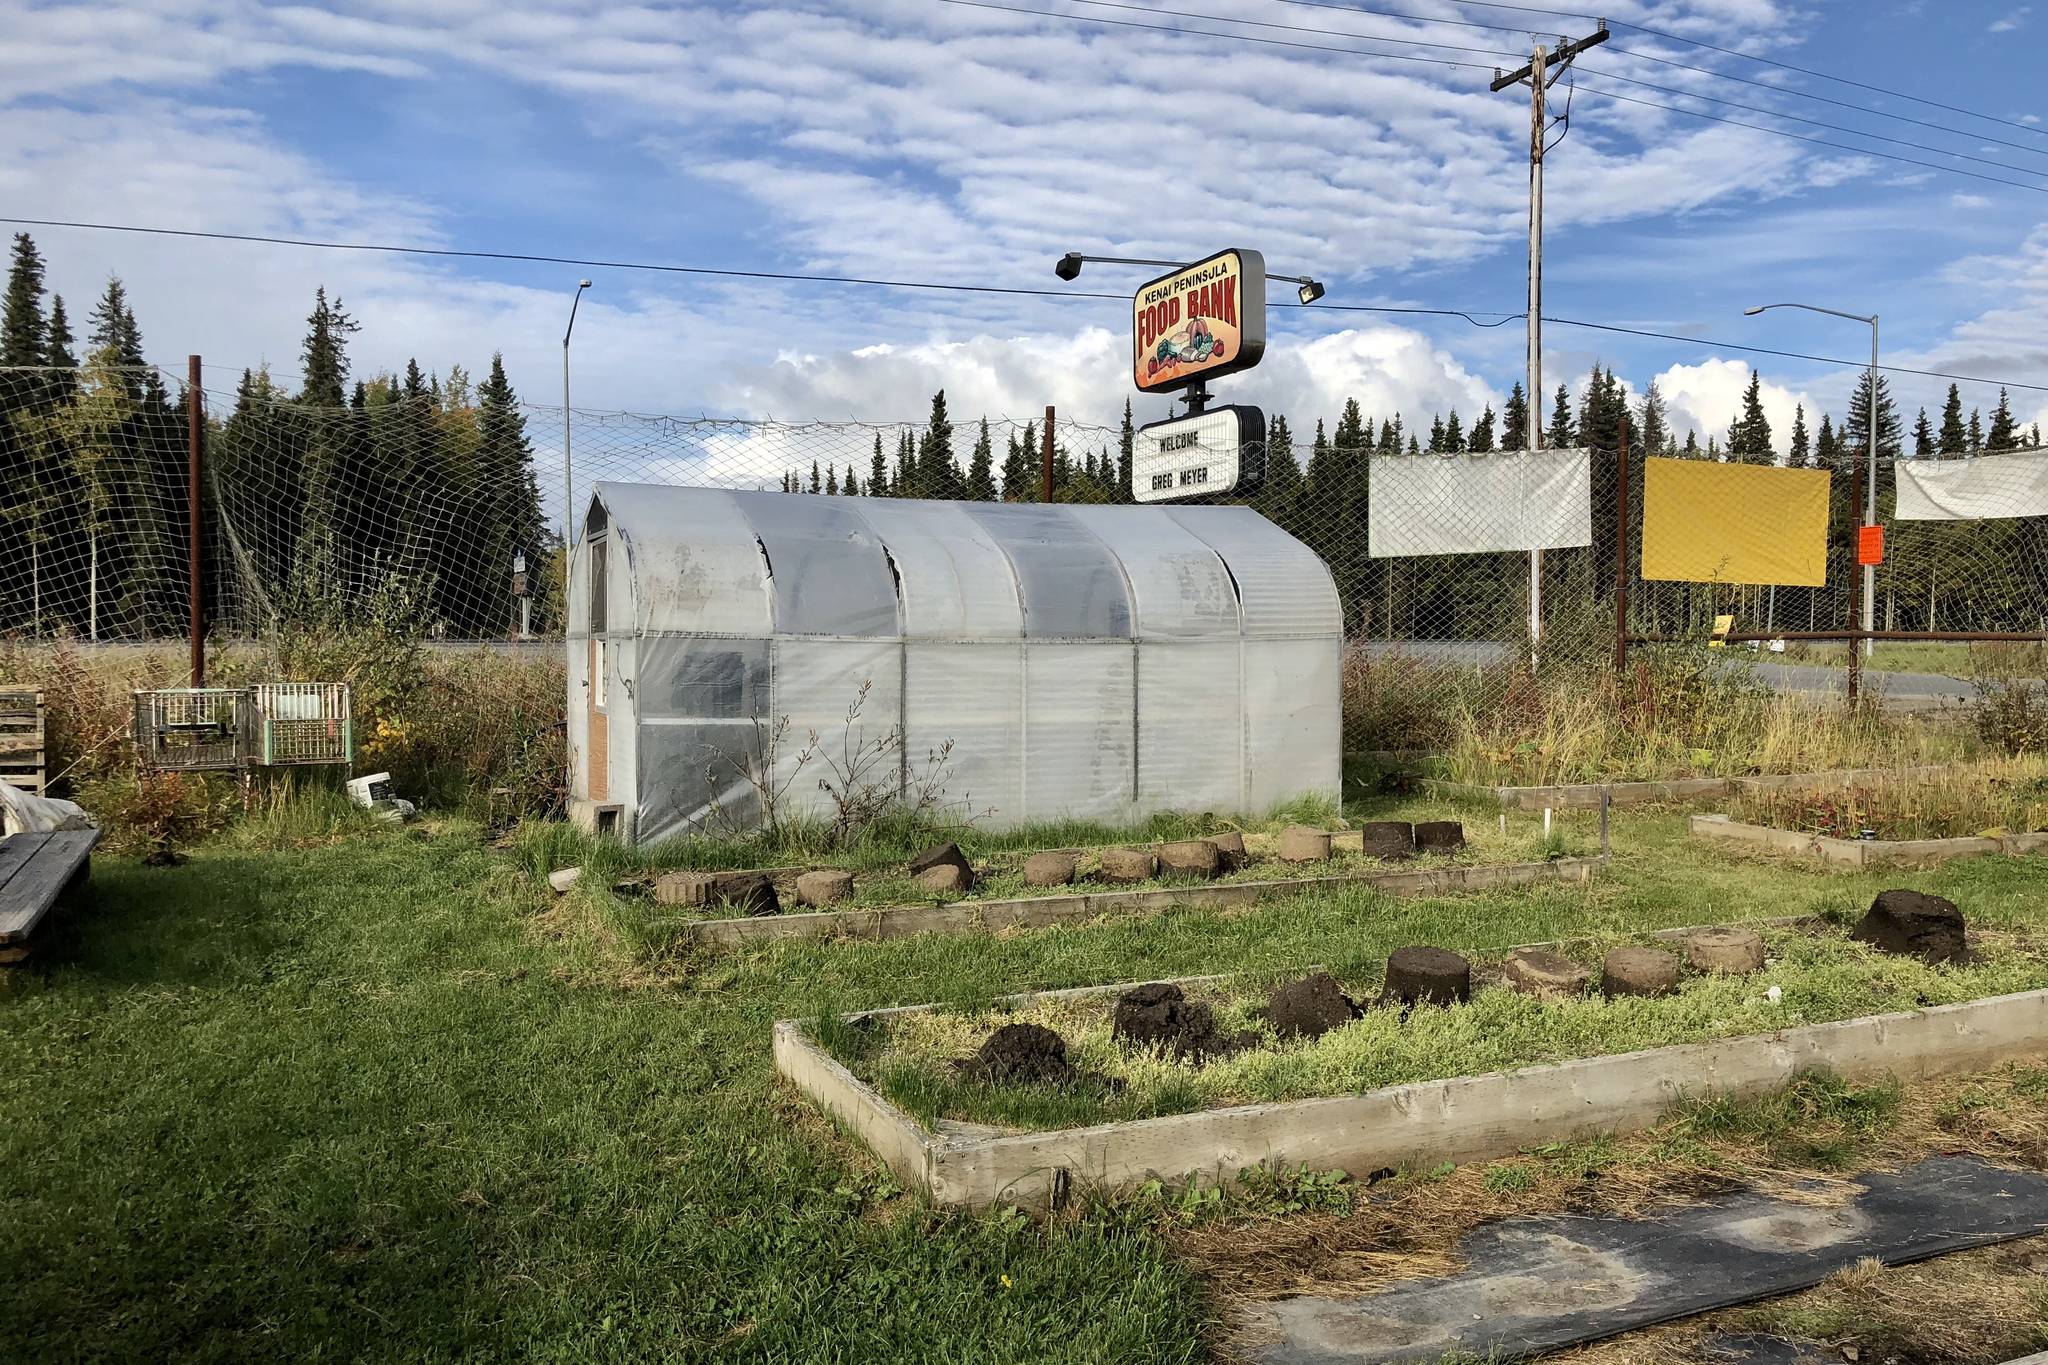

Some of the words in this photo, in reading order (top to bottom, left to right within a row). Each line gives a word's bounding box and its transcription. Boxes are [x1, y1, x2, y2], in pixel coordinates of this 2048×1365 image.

[1144, 286, 1171, 305] KENAI
[1137, 296, 1180, 360] FOOD
[1187, 274, 1238, 328] BANK
[1160, 431, 1199, 453] WELCOME
[1152, 473, 1173, 490] GREG
[1180, 467, 1208, 485] MEYER
